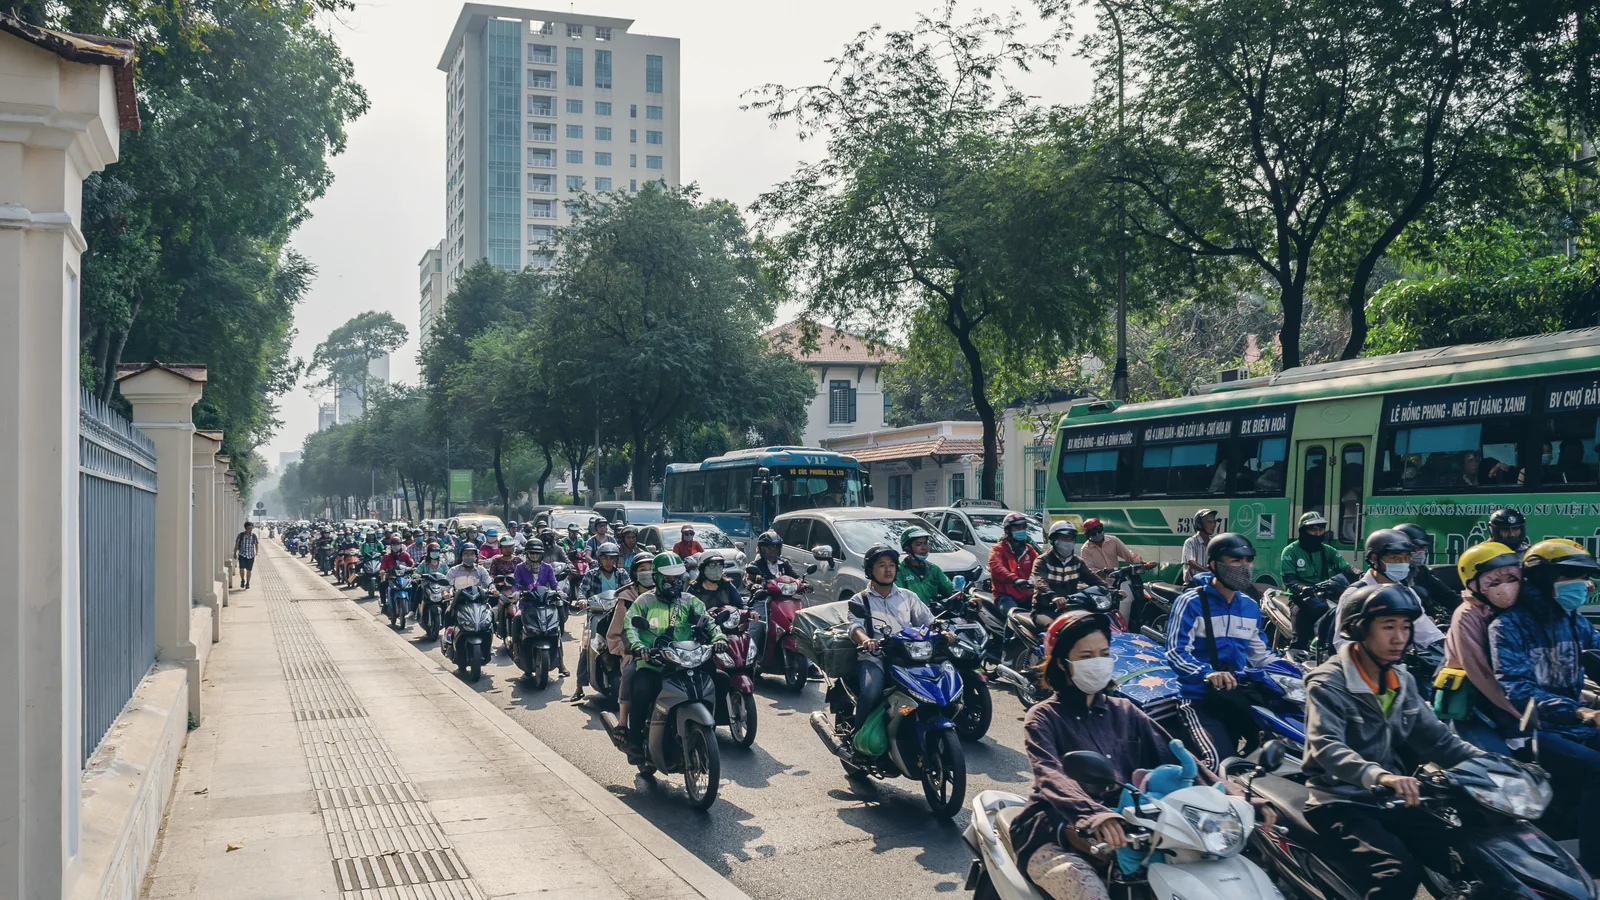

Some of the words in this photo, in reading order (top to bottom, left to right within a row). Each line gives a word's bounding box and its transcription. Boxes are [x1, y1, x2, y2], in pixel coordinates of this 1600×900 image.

[1549, 392, 1562, 408] BV
[1564, 387, 1583, 409] CHỢ
[1390, 404, 1400, 422] LÊ
[1401, 401, 1421, 421] HỒNG
[1421, 404, 1446, 420] PHONG
[1452, 398, 1467, 417] NGÃ
[1469, 398, 1480, 416] TƯ
[1481, 395, 1502, 415] HÀNG
[1503, 396, 1526, 413] XANH
[1241, 420, 1252, 434] BX
[1252, 415, 1270, 433] BIÊN
[804, 456, 828, 464] VIP
[1368, 503, 1388, 517] TẬP
[1388, 502, 1420, 516] ĐOÀN
[1421, 502, 1454, 516] CÔNG
[1534, 503, 1552, 515] SU
[1554, 502, 1588, 518] VIỆT
